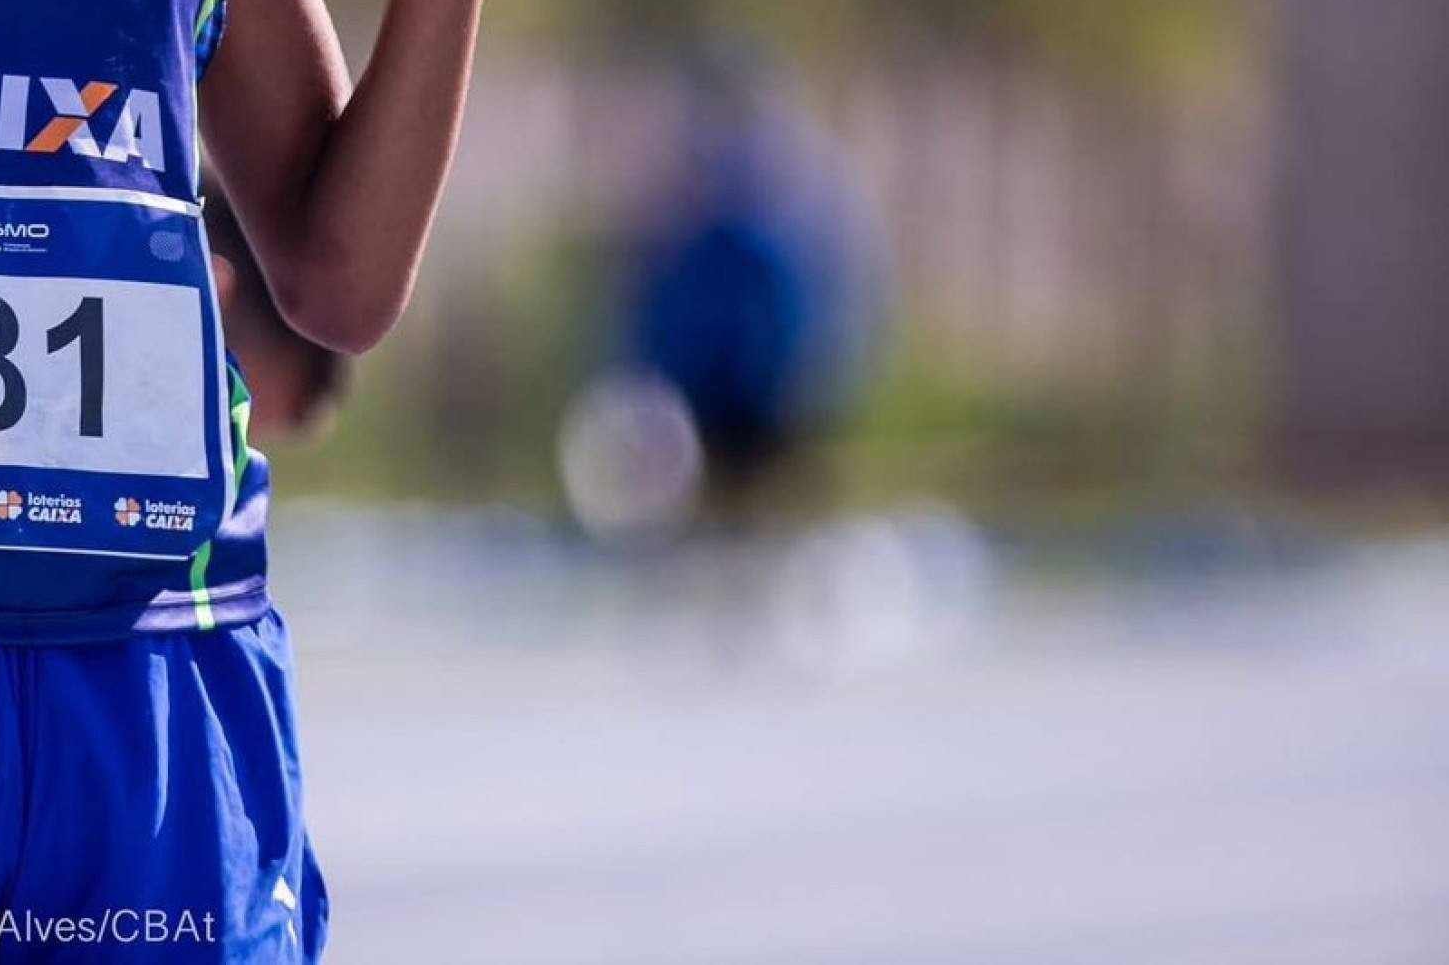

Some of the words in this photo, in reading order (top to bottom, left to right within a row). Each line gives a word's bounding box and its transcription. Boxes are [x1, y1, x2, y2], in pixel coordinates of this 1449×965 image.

[28, 491, 82, 508] loterias
[145, 498, 196, 515] loterias
[28, 507, 82, 524] CAIXA
[145, 514, 194, 531] CAIXA
